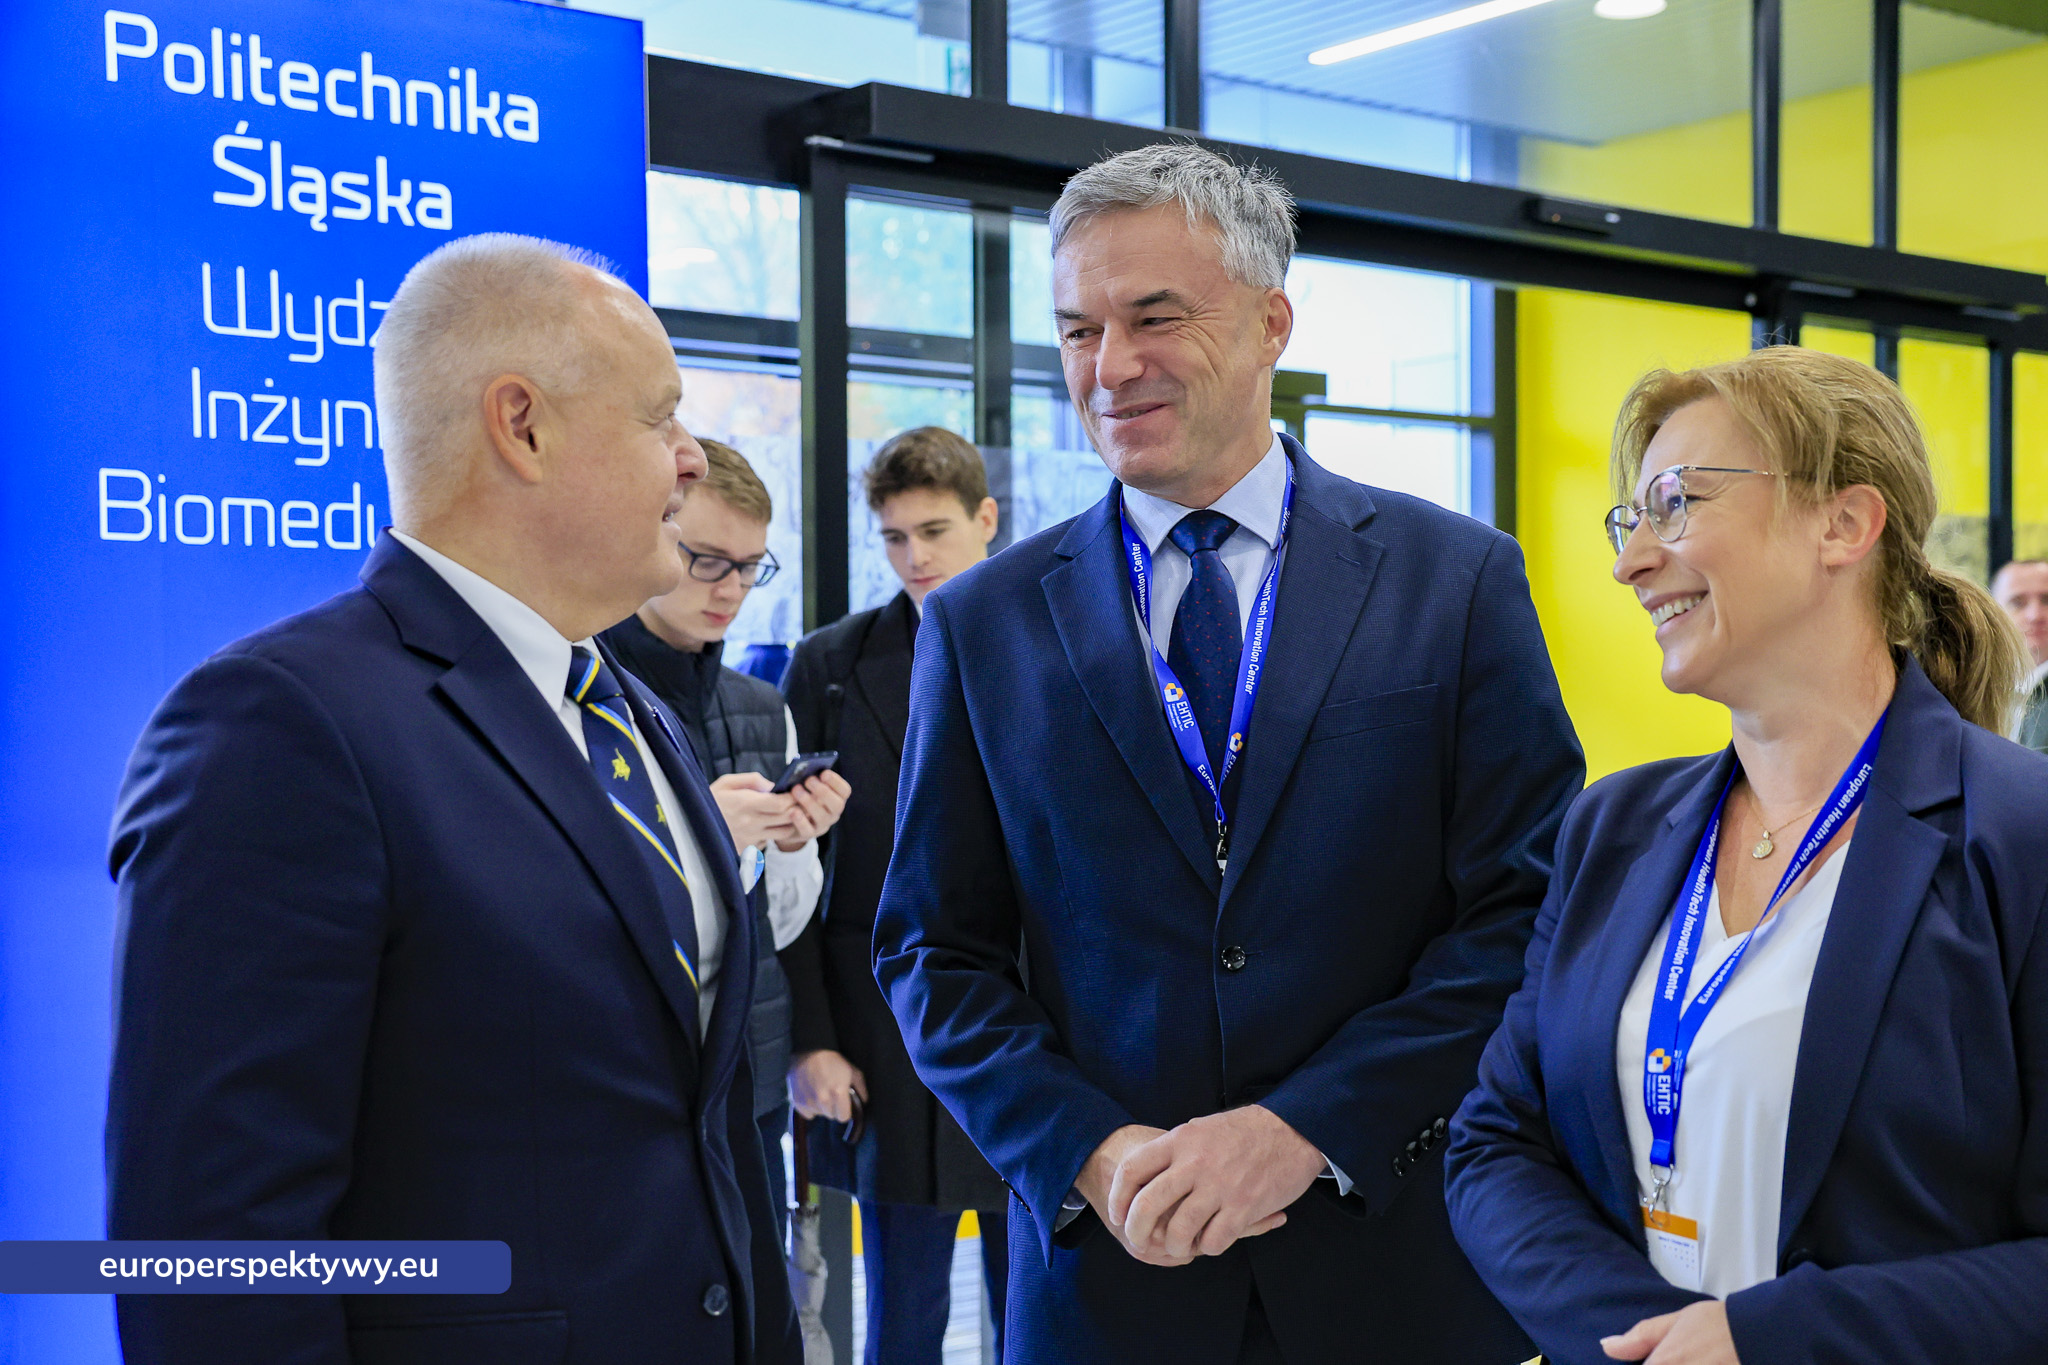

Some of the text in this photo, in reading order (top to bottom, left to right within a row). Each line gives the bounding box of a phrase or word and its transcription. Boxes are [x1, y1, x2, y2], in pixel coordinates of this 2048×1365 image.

[104, 9, 540, 143] Politechnika
[213, 121, 453, 232] Śląska
[202, 262, 393, 364] Wydz
[191, 367, 383, 467] Inżyn
[1131, 542, 1144, 572] Center
[1250, 616, 1268, 663] Innovation
[1244, 662, 1260, 695] Center
[1176, 700, 1195, 729] EHTIC
[1197, 763, 1217, 796] Europ
[1838, 762, 1873, 810] European
[1799, 806, 1843, 863] HealthTech
[1687, 861, 1711, 917] HealthTech
[1673, 913, 1698, 967] Innovation
[1663, 965, 1684, 1002] Center
[1657, 1074, 1671, 1116] EHTIC
